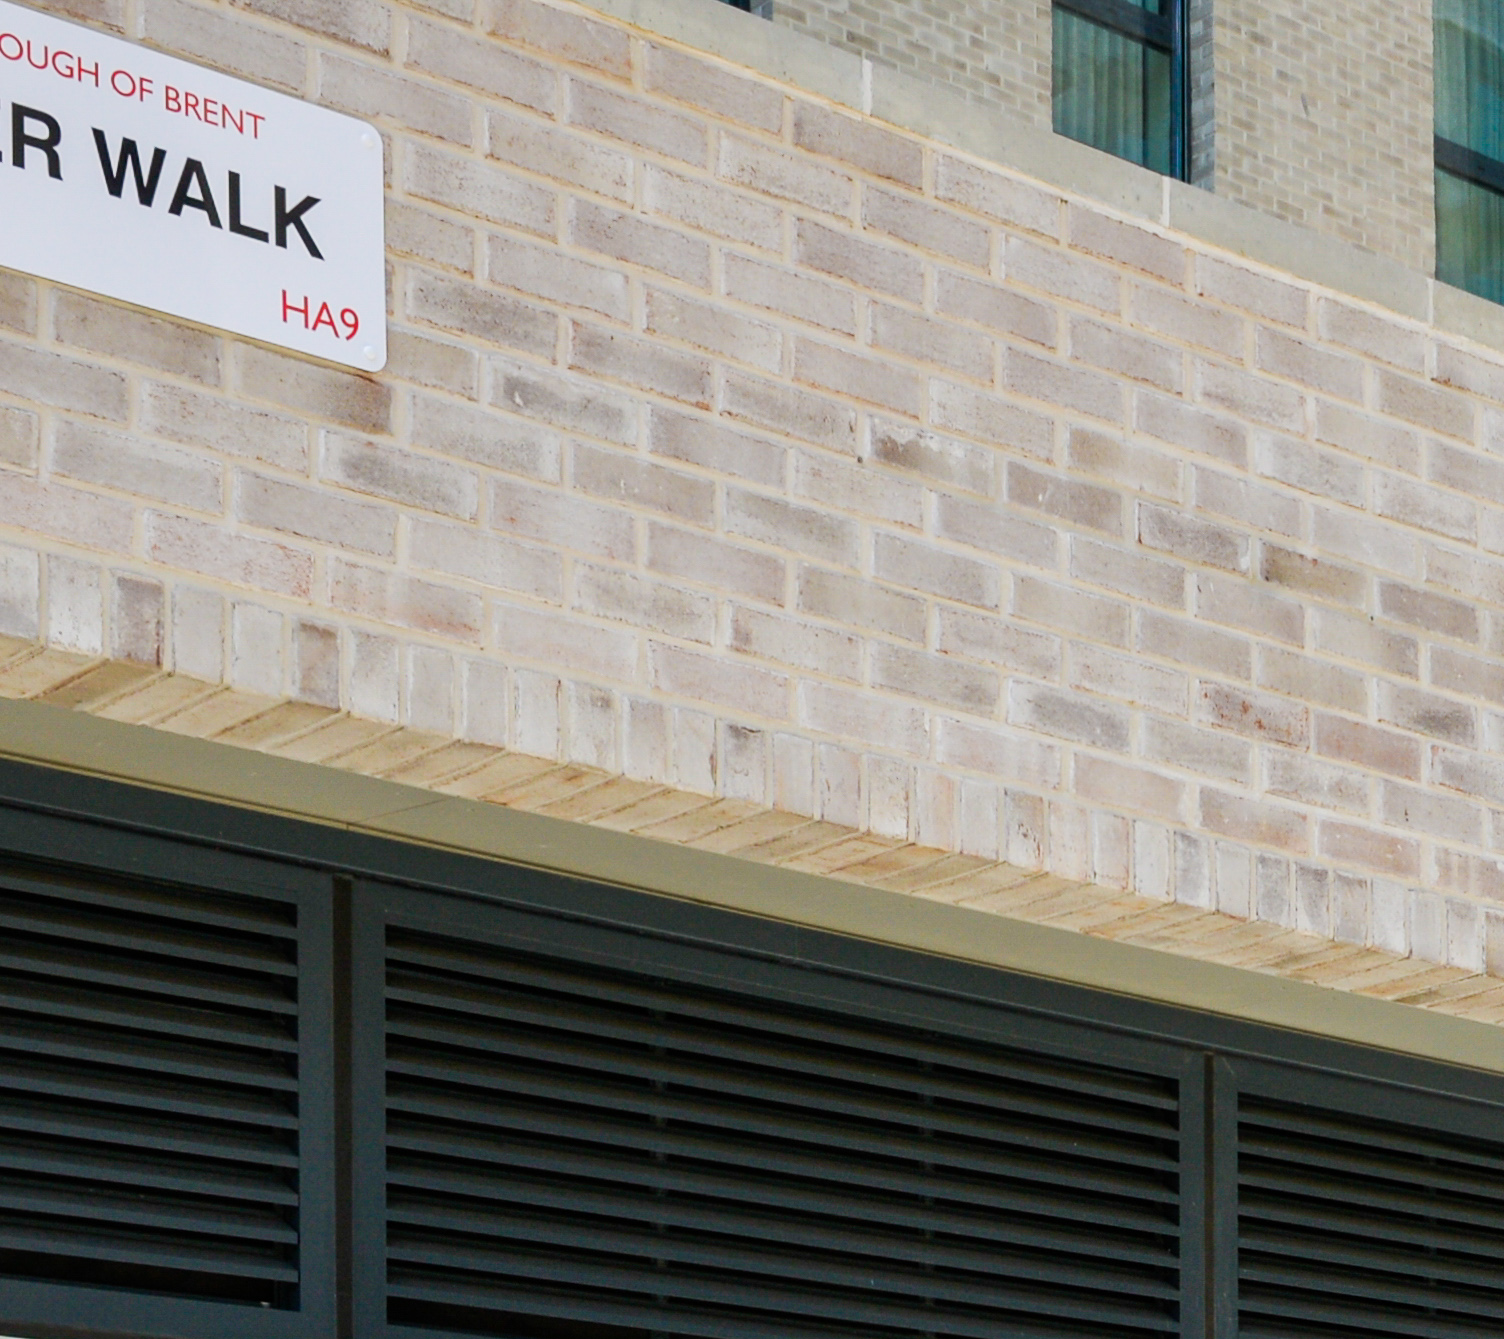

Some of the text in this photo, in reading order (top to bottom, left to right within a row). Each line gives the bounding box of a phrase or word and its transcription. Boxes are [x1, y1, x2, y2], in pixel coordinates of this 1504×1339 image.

[112, 69, 155, 104] OF
[165, 88, 266, 140] BRENT
[92, 126, 325, 261] WALK
[280, 290, 360, 343] HA9
